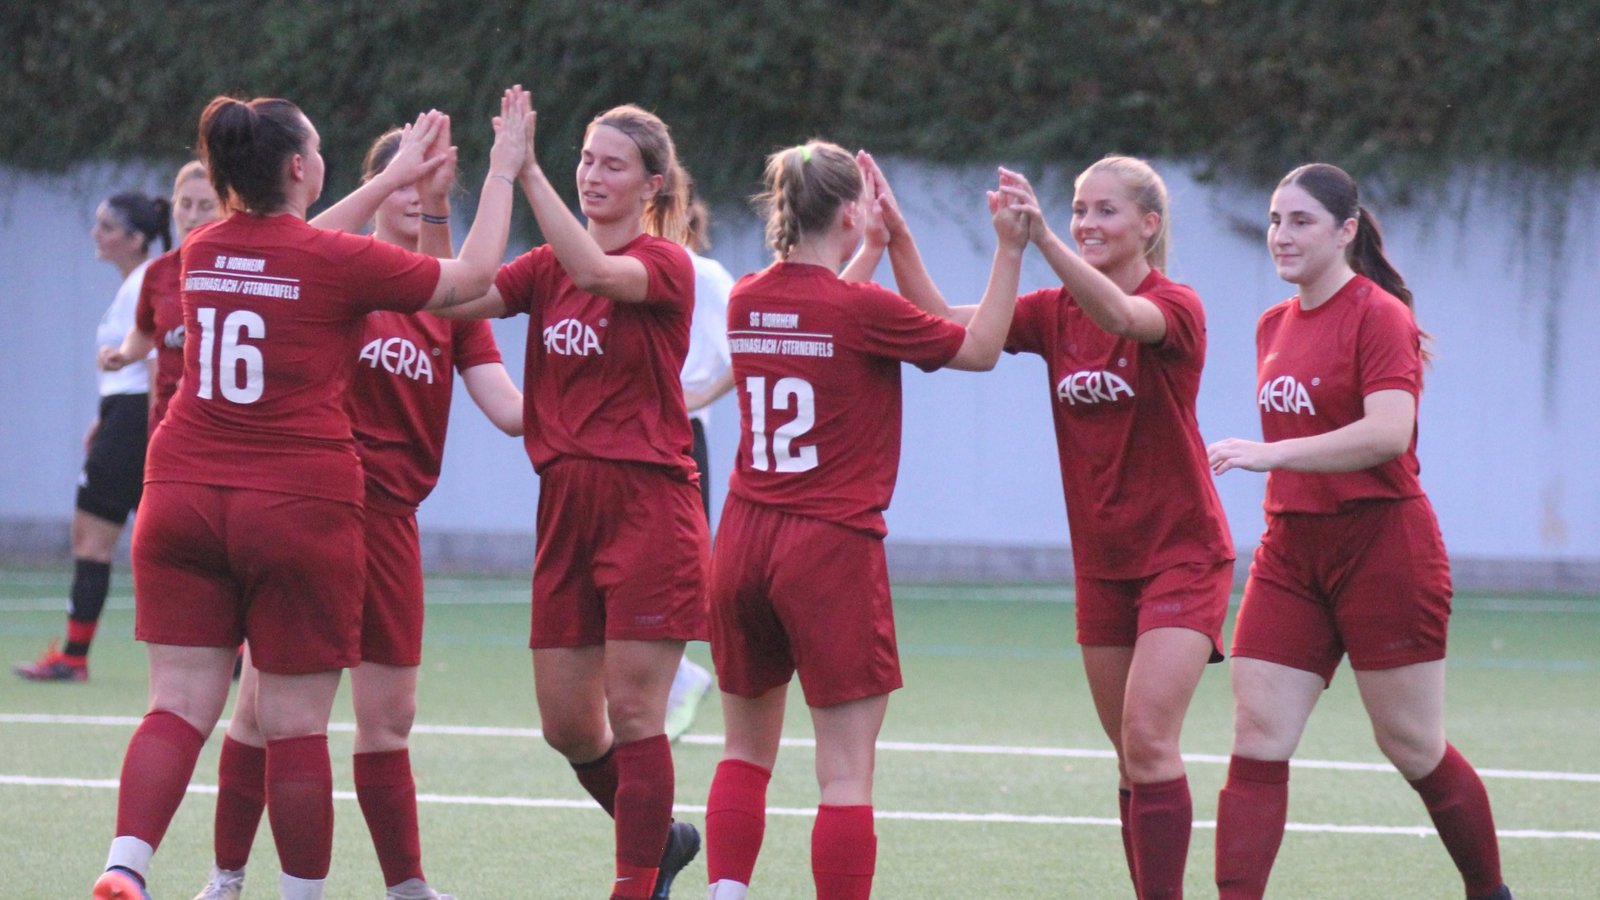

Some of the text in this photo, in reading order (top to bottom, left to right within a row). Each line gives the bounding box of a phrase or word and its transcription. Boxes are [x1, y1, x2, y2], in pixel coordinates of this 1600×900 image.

[215, 255, 227, 269] SG
[242, 281, 300, 300] STERNENFELS
[542, 318, 604, 356] AERA
[749, 311, 760, 327] SG
[196, 307, 267, 404] 16
[358, 337, 434, 385] AERA
[781, 340, 834, 357] STERNENFELS
[1057, 371, 1135, 405] AERA
[1258, 375, 1316, 416] AERA
[745, 376, 819, 473] 12
